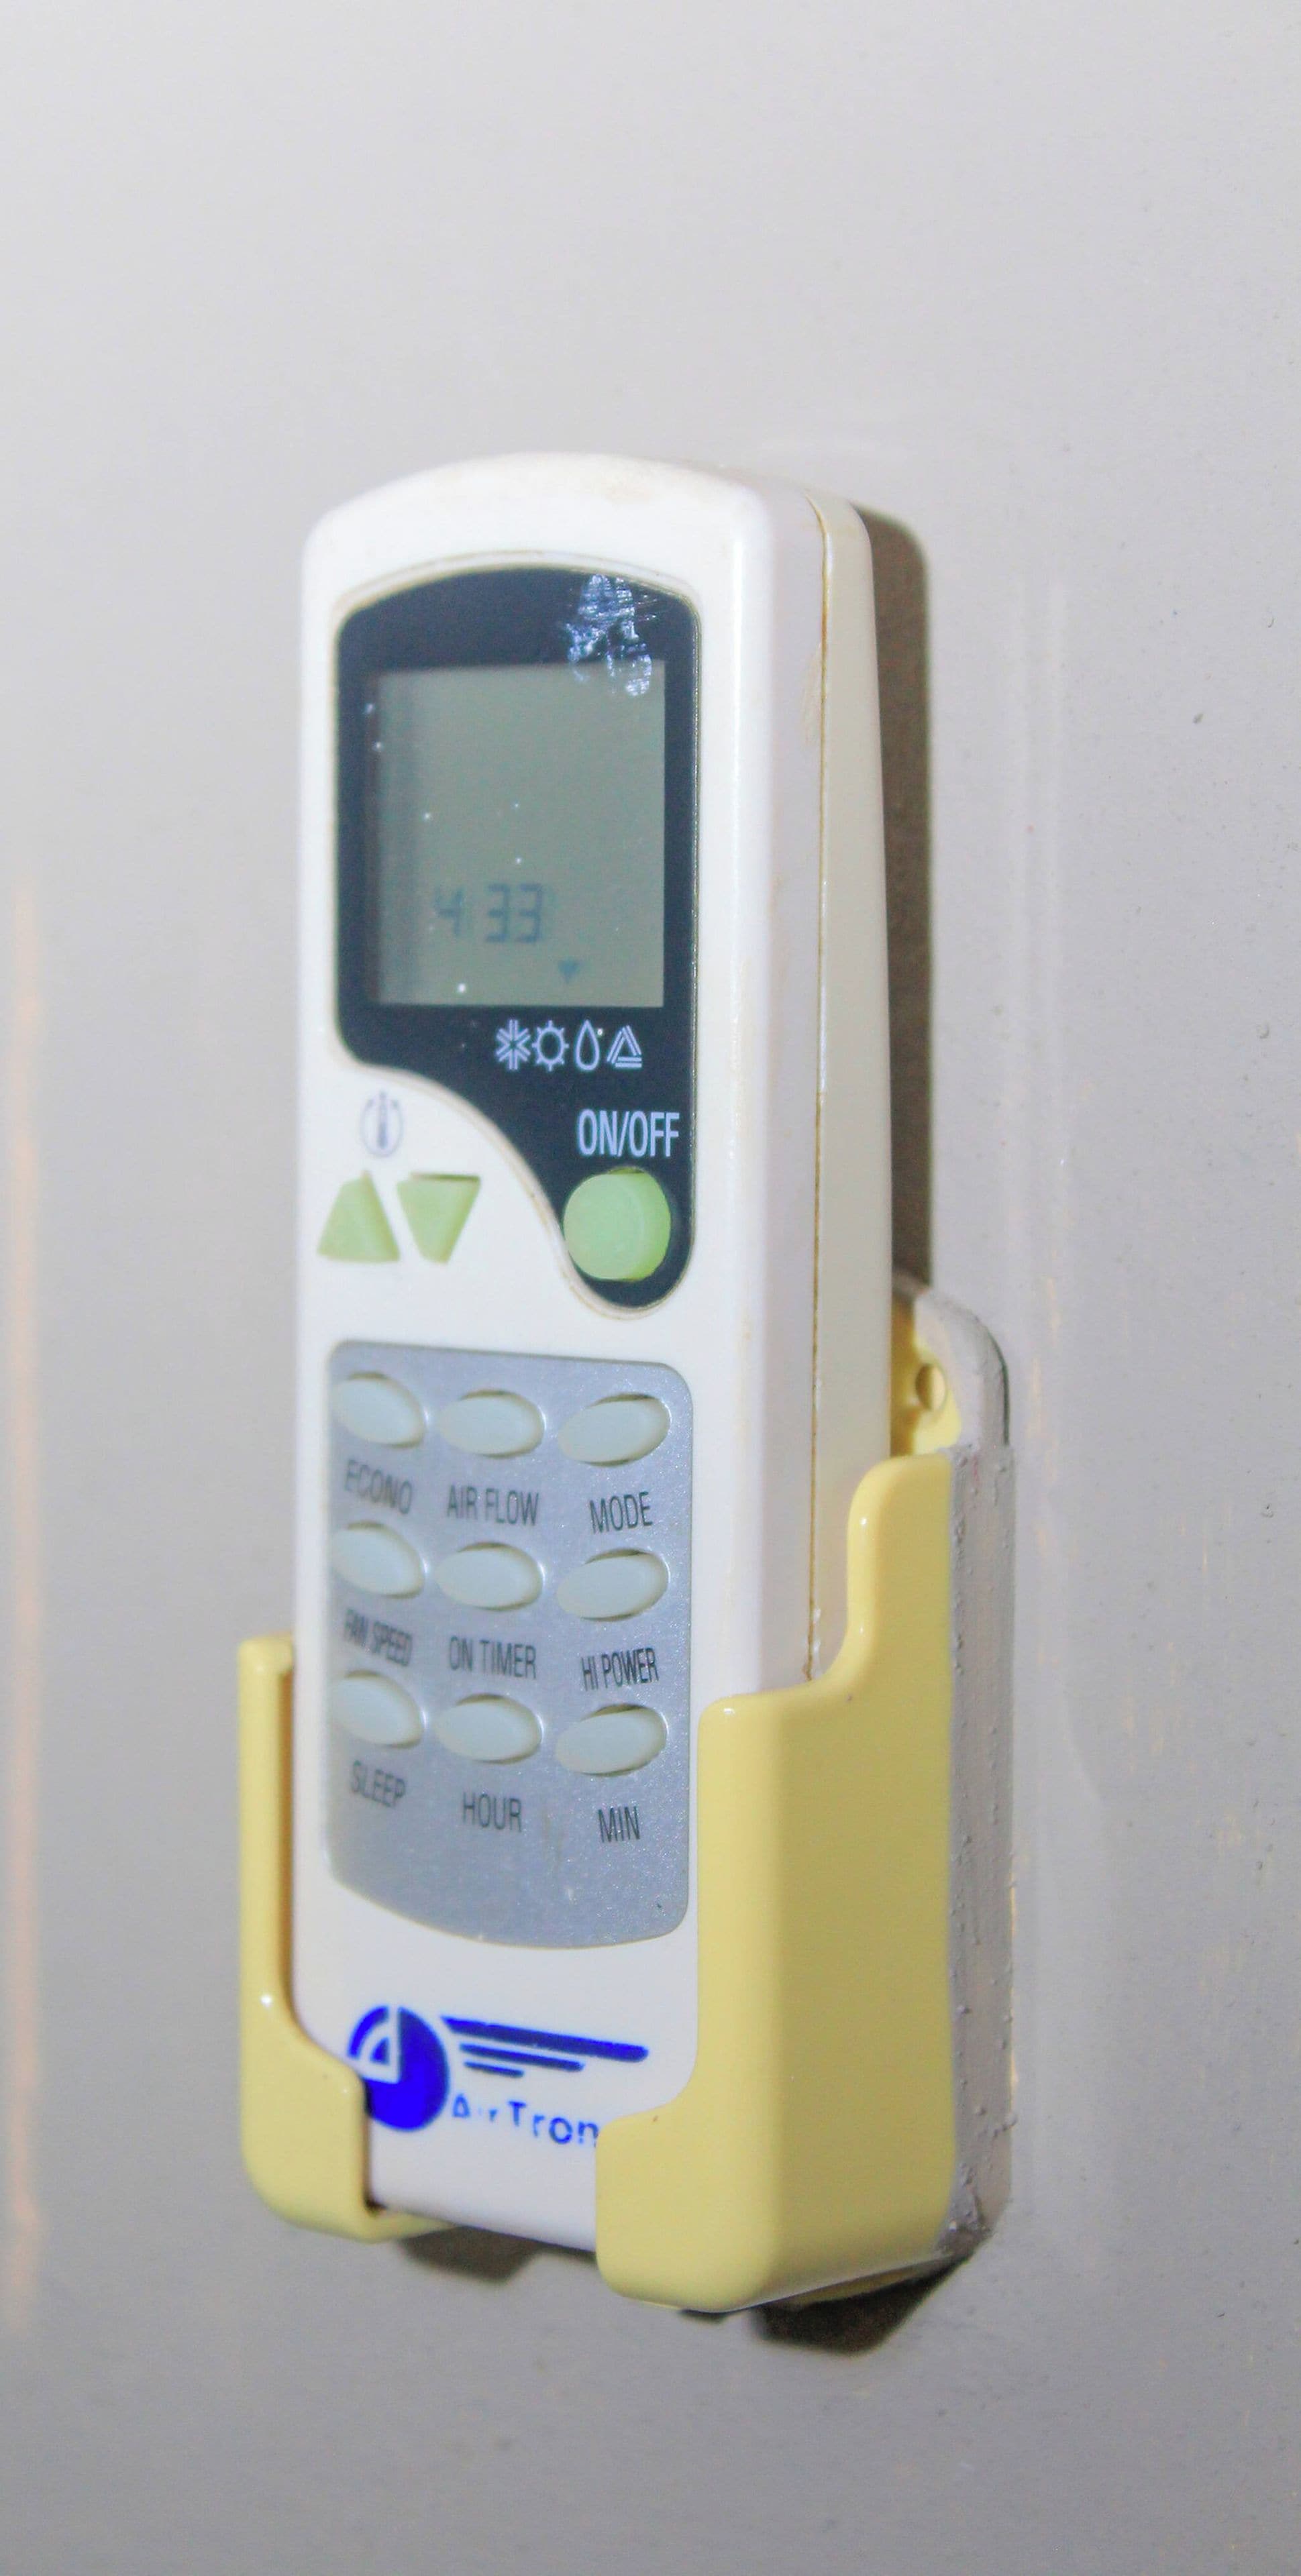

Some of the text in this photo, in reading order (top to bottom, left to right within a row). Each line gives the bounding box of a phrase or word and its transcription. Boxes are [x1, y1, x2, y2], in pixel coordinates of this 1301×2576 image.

[576, 1108, 680, 1157] ON/OFF
[344, 1459, 413, 1515] ECONO
[447, 1484, 539, 1525] AIR FLOW
[588, 1491, 654, 1534] MODE
[344, 1609, 413, 1667] FAN SPEED
[448, 1635, 536, 1678] ON TIMER
[580, 1647, 660, 1691] HI POWER
[350, 1759, 407, 1807] SLEEP
[462, 1790, 522, 1833] HOUR
[597, 1805, 640, 1843] MIN
[452, 2093, 599, 2147] ArTron
